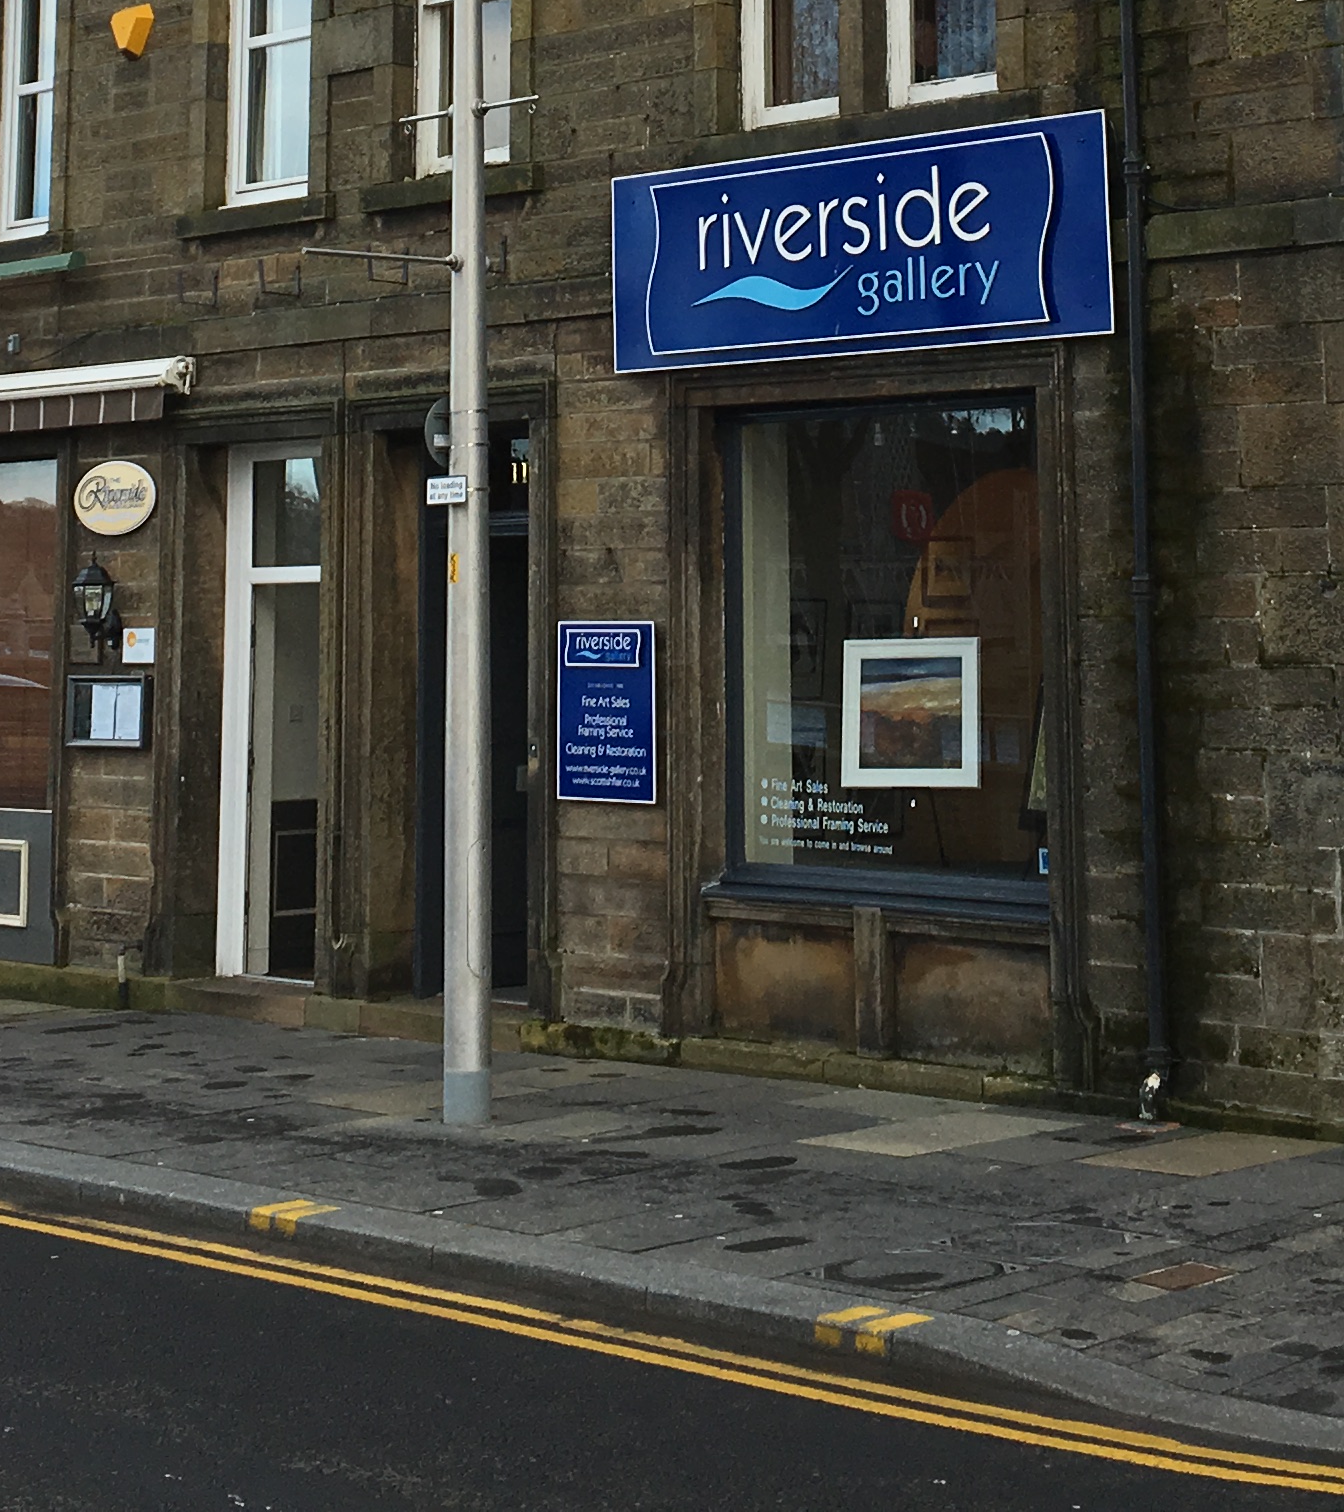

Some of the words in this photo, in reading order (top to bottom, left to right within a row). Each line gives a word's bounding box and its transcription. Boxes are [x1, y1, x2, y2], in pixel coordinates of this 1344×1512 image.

[698, 165, 990, 270] riverside
[857, 257, 1000, 316] gallery
[441, 481, 462, 490] loading
[78, 476, 147, 512] Riverside
[429, 492, 436, 500] at
[438, 492, 448, 500] any
[576, 632, 632, 650] riverside
[581, 695, 597, 707] Fine
[597, 696, 610, 707] Art
[611, 696, 630, 708] Sales
[584, 713, 627, 726] Professional
[578, 724, 605, 739] Framing
[606, 725, 634, 738] Service
[565, 742, 596, 758] Cleaning
[597, 744, 605, 756] &
[606, 744, 647, 757] Restoration
[771, 778, 788, 792] Fine
[790, 779, 803, 793] Art
[806, 779, 828, 794] Sales
[770, 796, 804, 814] Cleaning
[807, 797, 814, 812] &
[817, 798, 864, 814] Restoration
[771, 813, 819, 829] Professional
[822, 816, 855, 835] Framing
[857, 818, 889, 834] Service
[806, 838, 813, 849] to
[814, 840, 830, 850] come
[839, 840, 849, 851] and
[850, 841, 871, 853] browse
